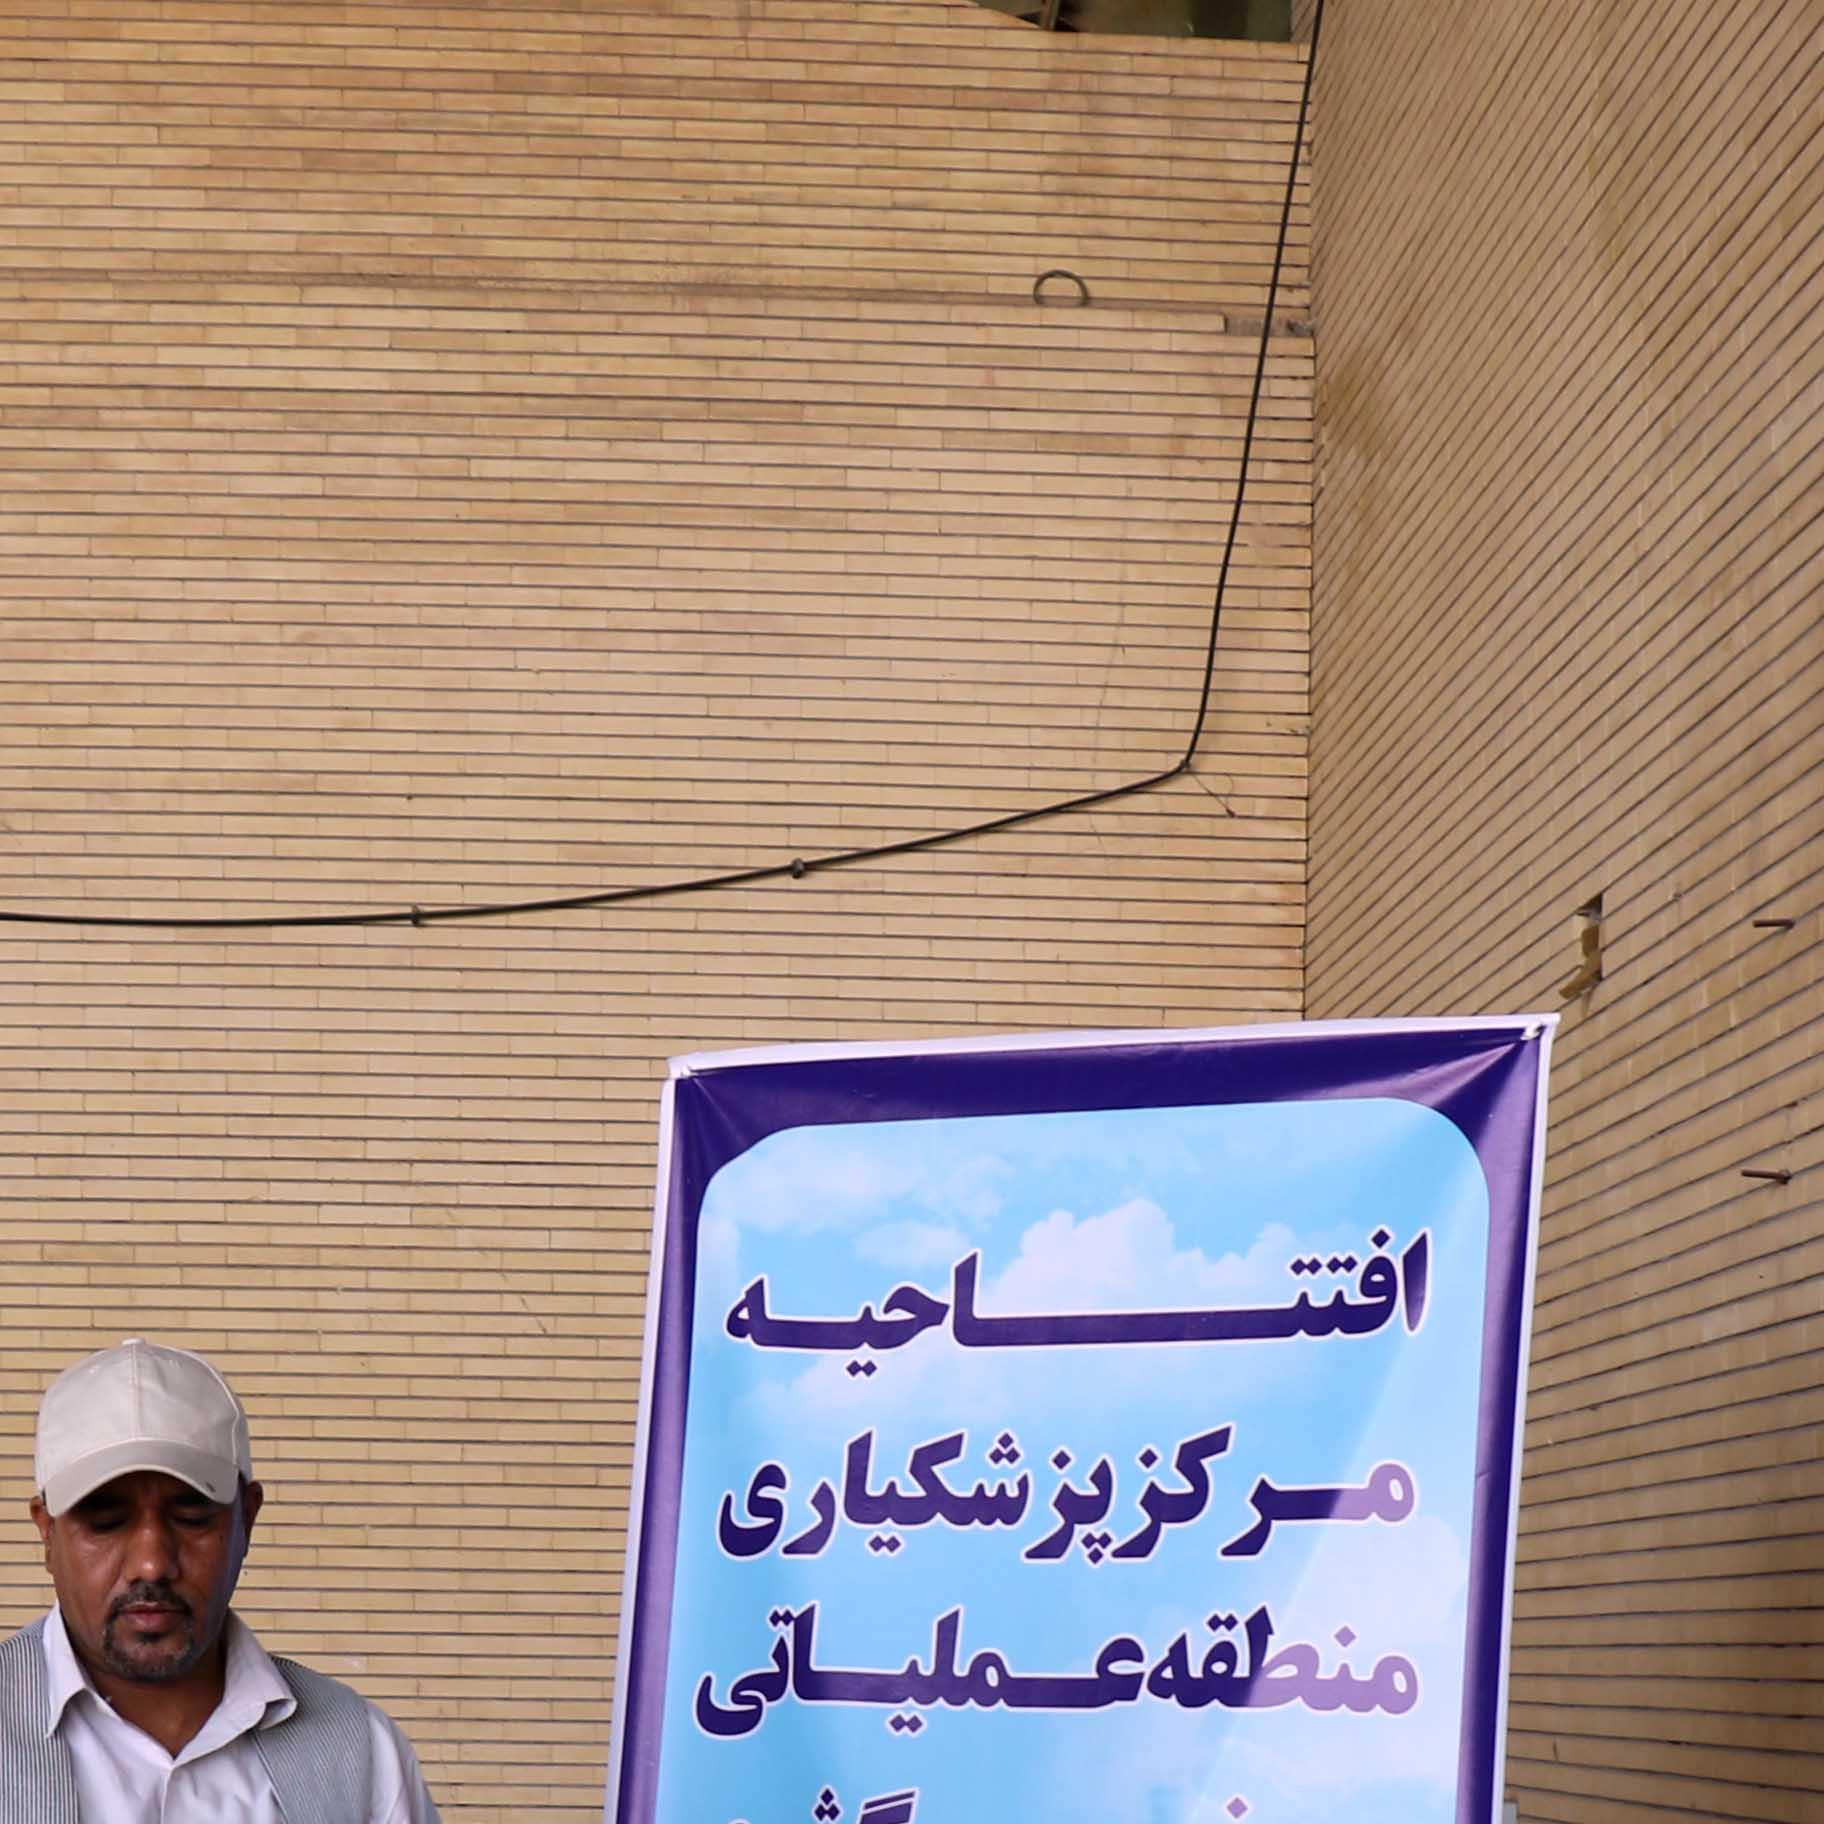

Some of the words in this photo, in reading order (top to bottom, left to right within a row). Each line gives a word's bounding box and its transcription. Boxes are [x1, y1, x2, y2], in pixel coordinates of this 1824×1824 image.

[725, 1227, 1429, 1378] افتتاحیه
[719, 1429, 1115, 1564] پزشکیاری
[1110, 1424, 1416, 1560] مرکز
[695, 1602, 1146, 1736] عملیاتی
[1146, 1603, 1419, 1715] منطقه
